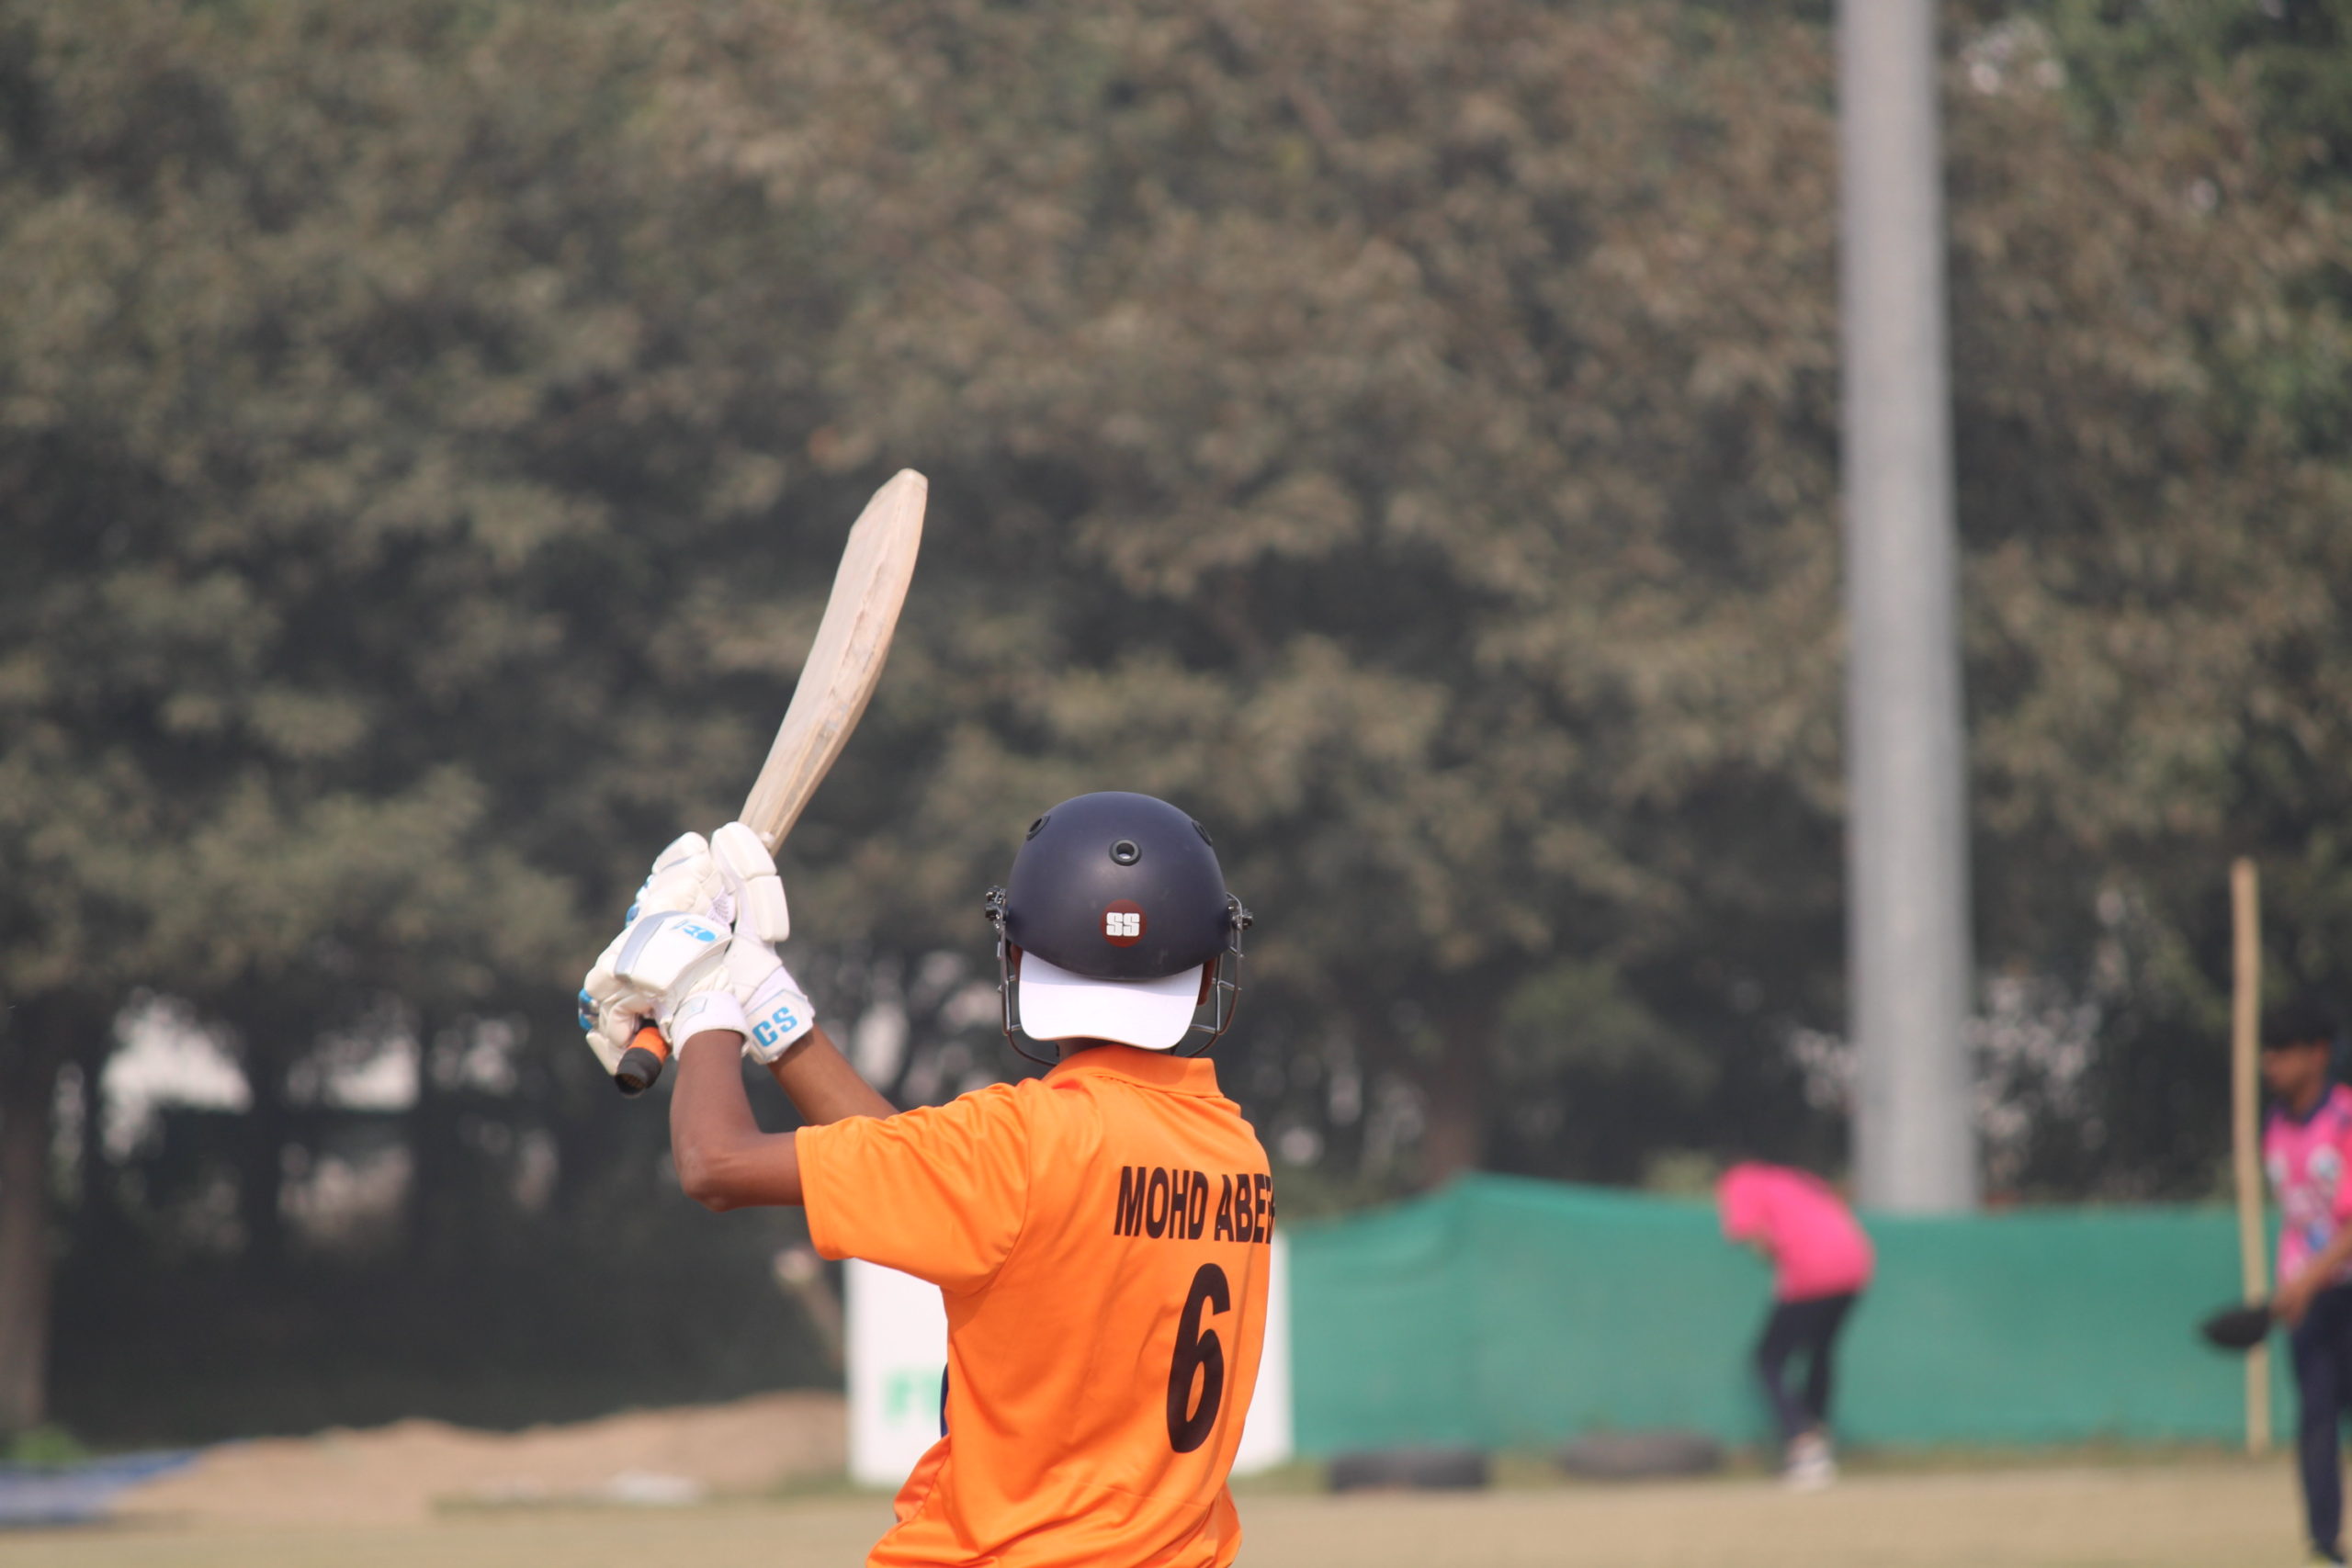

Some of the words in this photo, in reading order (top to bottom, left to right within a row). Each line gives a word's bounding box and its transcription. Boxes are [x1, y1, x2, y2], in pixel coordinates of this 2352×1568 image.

[1106, 911, 1140, 937] SS
[1114, 1166, 1209, 1240] MOHD
[1166, 1263, 1231, 1453] 6
